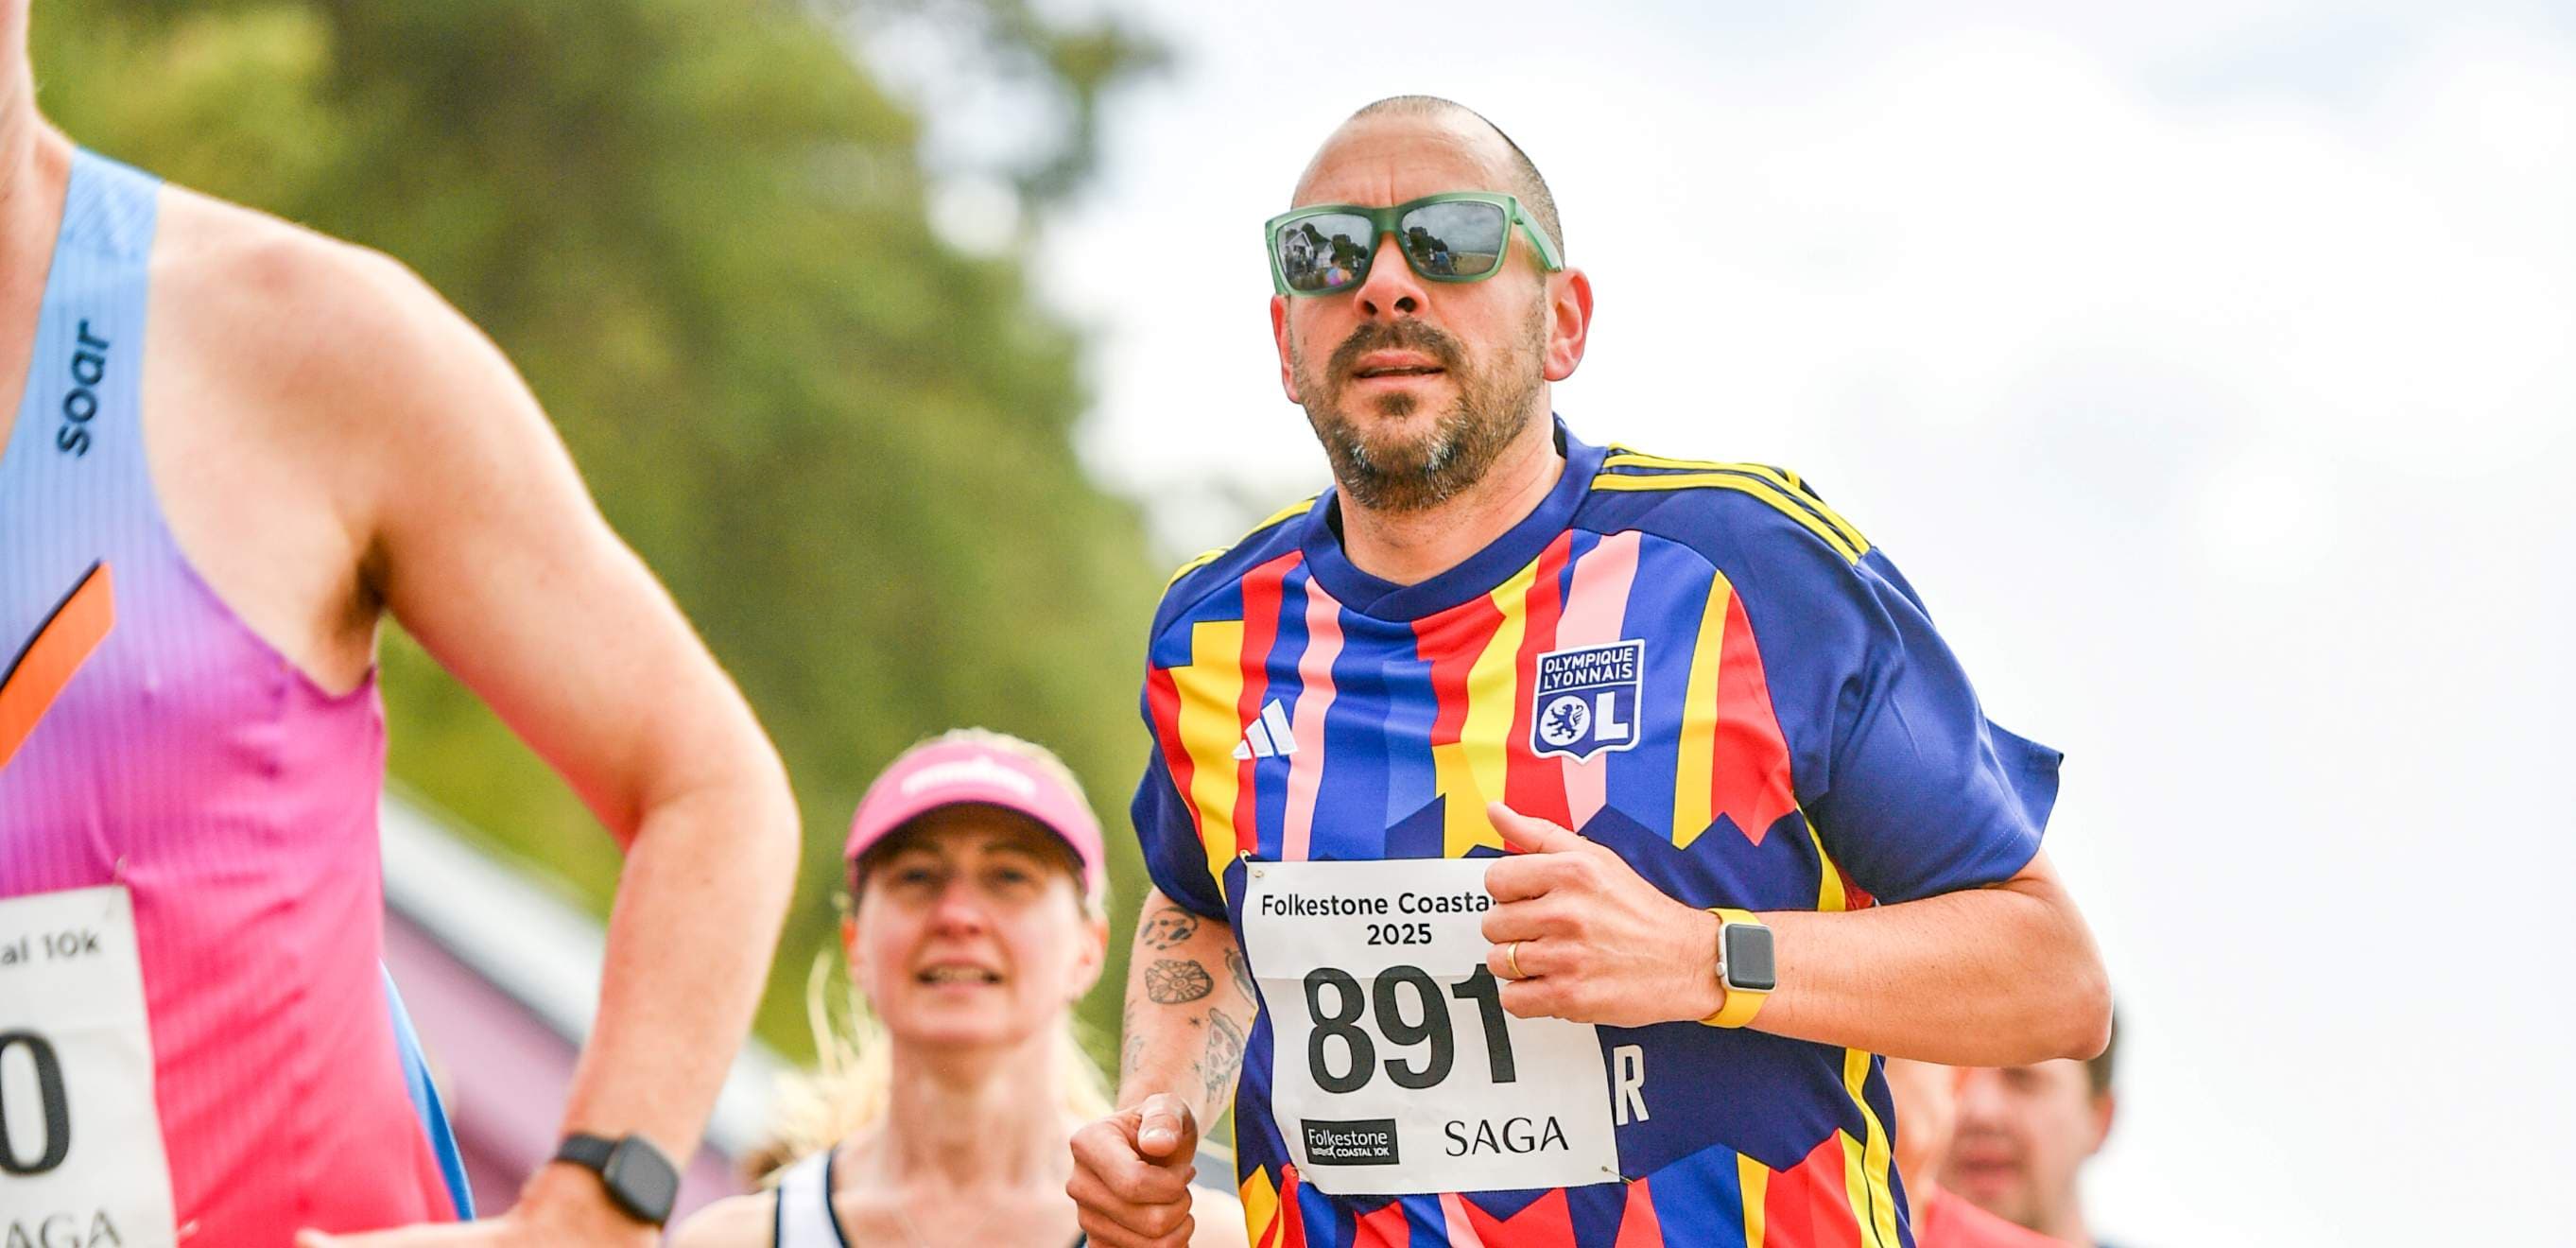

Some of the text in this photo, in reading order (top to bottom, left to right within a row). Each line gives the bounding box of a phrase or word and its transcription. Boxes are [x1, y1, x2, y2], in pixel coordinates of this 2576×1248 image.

[56, 318, 110, 458] soar
[1545, 648, 1634, 674] OLYMPIQUE
[1544, 663, 1634, 689] LYONNAIS
[1261, 892, 1496, 916] Folkestone Coasta
[41, 927, 102, 962] 10k
[1367, 923, 1432, 945] 2025
[1303, 962, 1517, 1093] 891
[1308, 1128, 1388, 1146] Folkestone
[1444, 1116, 1569, 1156] SAGA
[1336, 1148, 1372, 1157] COASTAL
